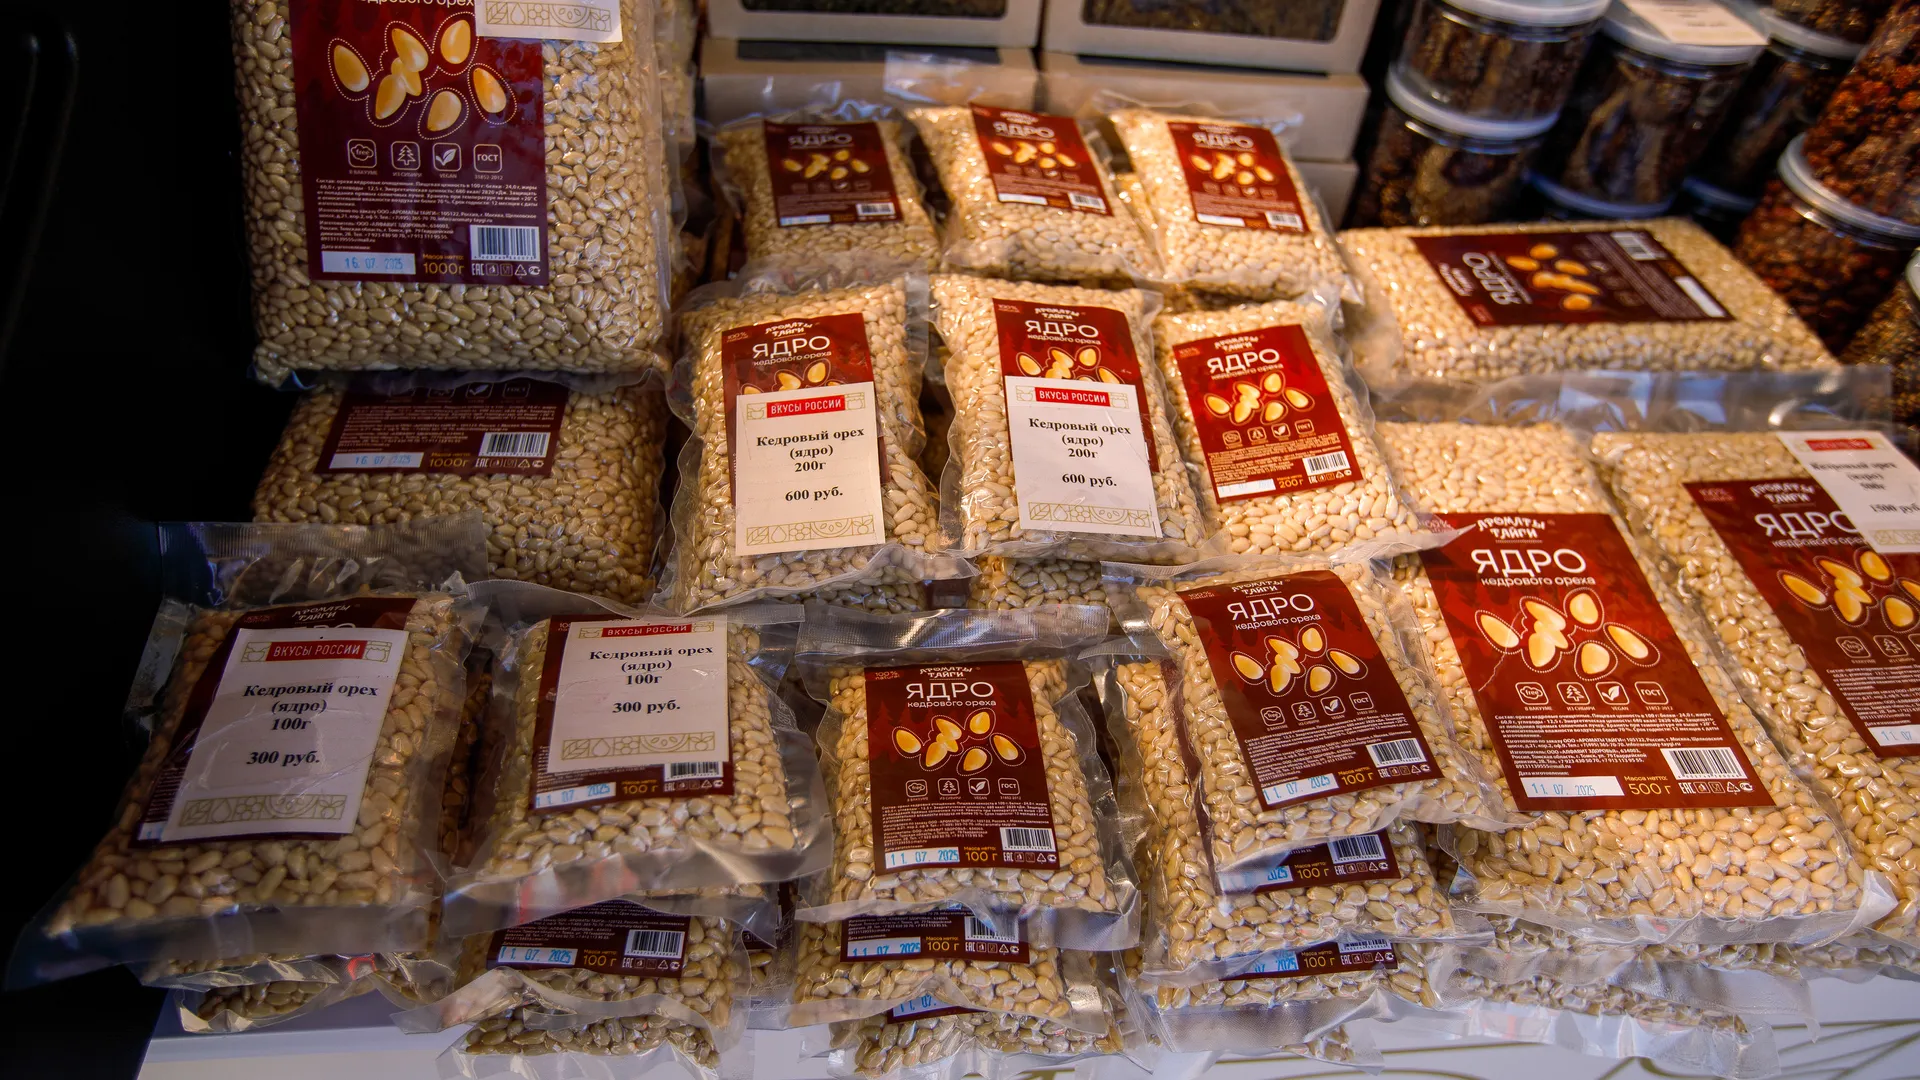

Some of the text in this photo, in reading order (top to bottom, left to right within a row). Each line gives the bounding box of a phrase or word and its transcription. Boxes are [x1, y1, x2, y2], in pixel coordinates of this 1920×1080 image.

[992, 122, 1054, 138] ЯДРО
[788, 134, 852, 146] ЯДРО
[1192, 132, 1254, 148] ЯДРО
[477, 154, 498, 162] ГОСТ
[423, 262, 465, 274] 1000г
[1462, 252, 1522, 305] ЯДРО
[1025, 320, 1098, 338] ЯДРО
[1027, 334, 1074, 343] кедрового
[752, 336, 830, 359] ЯДРО
[754, 351, 832, 366] кедрового ореха
[1206, 348, 1280, 374] ЯДРО
[1039, 390, 1106, 403] ВКУСЫ РОССИИ
[771, 399, 842, 414] ВКУСЫ РОССИИ
[1028, 418, 1132, 435] Кедровый орех
[756, 428, 865, 446] Кедровый орех
[1062, 434, 1104, 447] (ядро)
[790, 445, 833, 460] (ядро)
[1068, 448, 1098, 458] 200г
[430, 458, 468, 467] 1000г
[794, 460, 826, 472] 200г
[1810, 462, 1898, 472] Кедровый орех
[1062, 474, 1117, 487] 600 руб.
[1278, 479, 1298, 488] 200
[785, 486, 843, 501] 600 руб.
[1476, 516, 1545, 532] АРОМАТЫ
[1754, 510, 1859, 538] ЯДРО
[1490, 527, 1538, 539] ТАЙГИ
[1471, 548, 1586, 577] ЯДРО
[1231, 580, 1283, 593] АРОМАТЫ
[1481, 576, 1596, 588] кедрового ореха
[1241, 585, 1278, 595] ТАЙГИ
[1227, 594, 1314, 621] ЯДРО
[1235, 614, 1321, 630] кедрового ореха
[608, 625, 688, 636] ВКУСЫ РОССИИ
[273, 644, 360, 657] ВКУСЫ РОССИИ
[590, 646, 714, 660] Кедровый орех
[621, 660, 672, 672] (ядро)
[920, 666, 973, 674] АРОМАТЫ
[626, 674, 663, 685] 100г
[243, 682, 379, 698] Кедровый орех
[906, 682, 994, 701] ЯДРО
[271, 699, 327, 715] (ядро)
[612, 699, 680, 714] 300 руб.
[270, 717, 312, 730] 100г
[246, 750, 320, 766] 300 руб.
[1308, 776, 1330, 789] 2025
[1341, 774, 1365, 786] 100
[588, 783, 610, 796] 2025
[623, 784, 648, 795] 100
[1574, 785, 1596, 795] 2025
[1628, 783, 1671, 794] 500 г
[938, 849, 958, 861] 2025
[965, 852, 988, 862] 100
[1296, 867, 1330, 879] 100 г
[927, 941, 960, 951] 100 г
[548, 949, 572, 963] 2025
[583, 955, 617, 966] 100 г
[1303, 956, 1335, 968] 100 г
